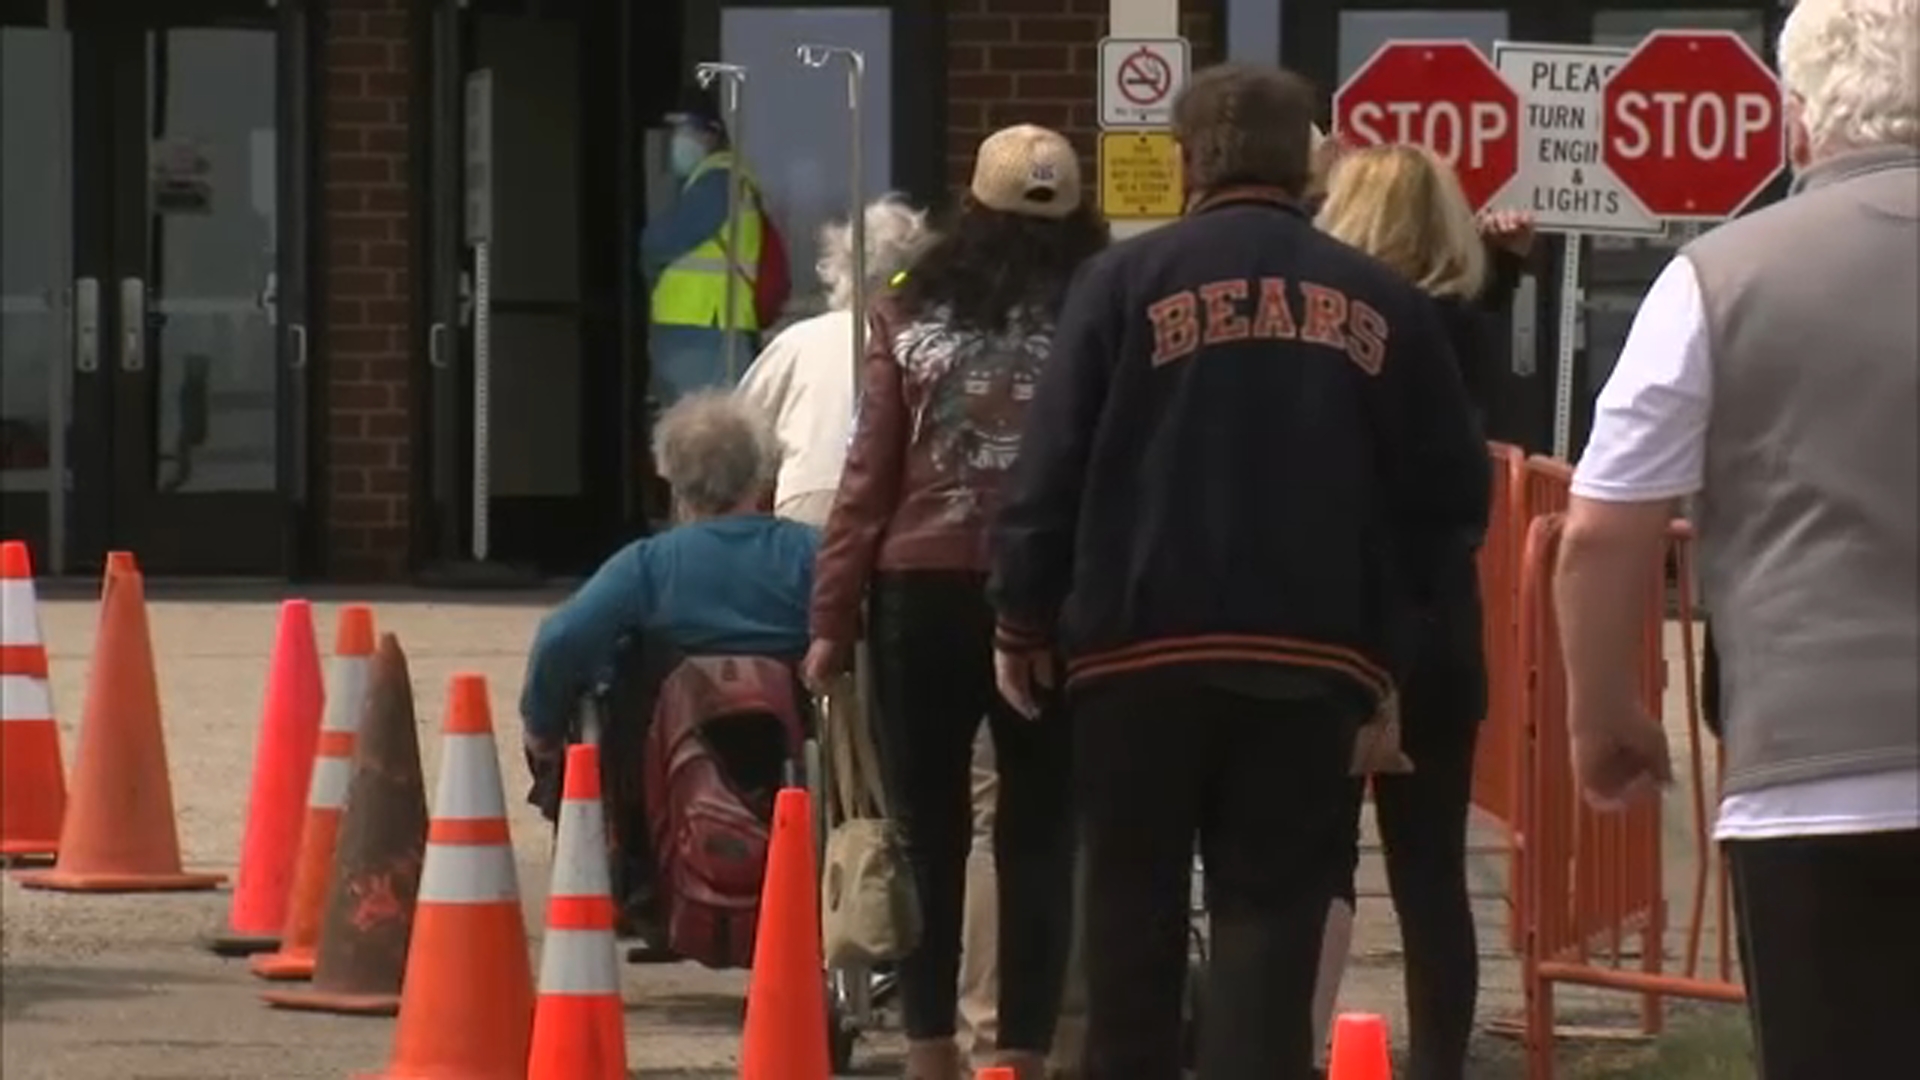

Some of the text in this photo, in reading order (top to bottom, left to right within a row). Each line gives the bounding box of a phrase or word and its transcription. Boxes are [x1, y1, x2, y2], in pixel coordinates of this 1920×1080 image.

[1350, 101, 1508, 169] STOP
[1528, 103, 1585, 129] TURN
[1613, 91, 1772, 161] STOP
[1532, 186, 1619, 215] LIGHTS
[1571, 168, 1584, 186] &
[1147, 277, 1389, 376] BEARS
